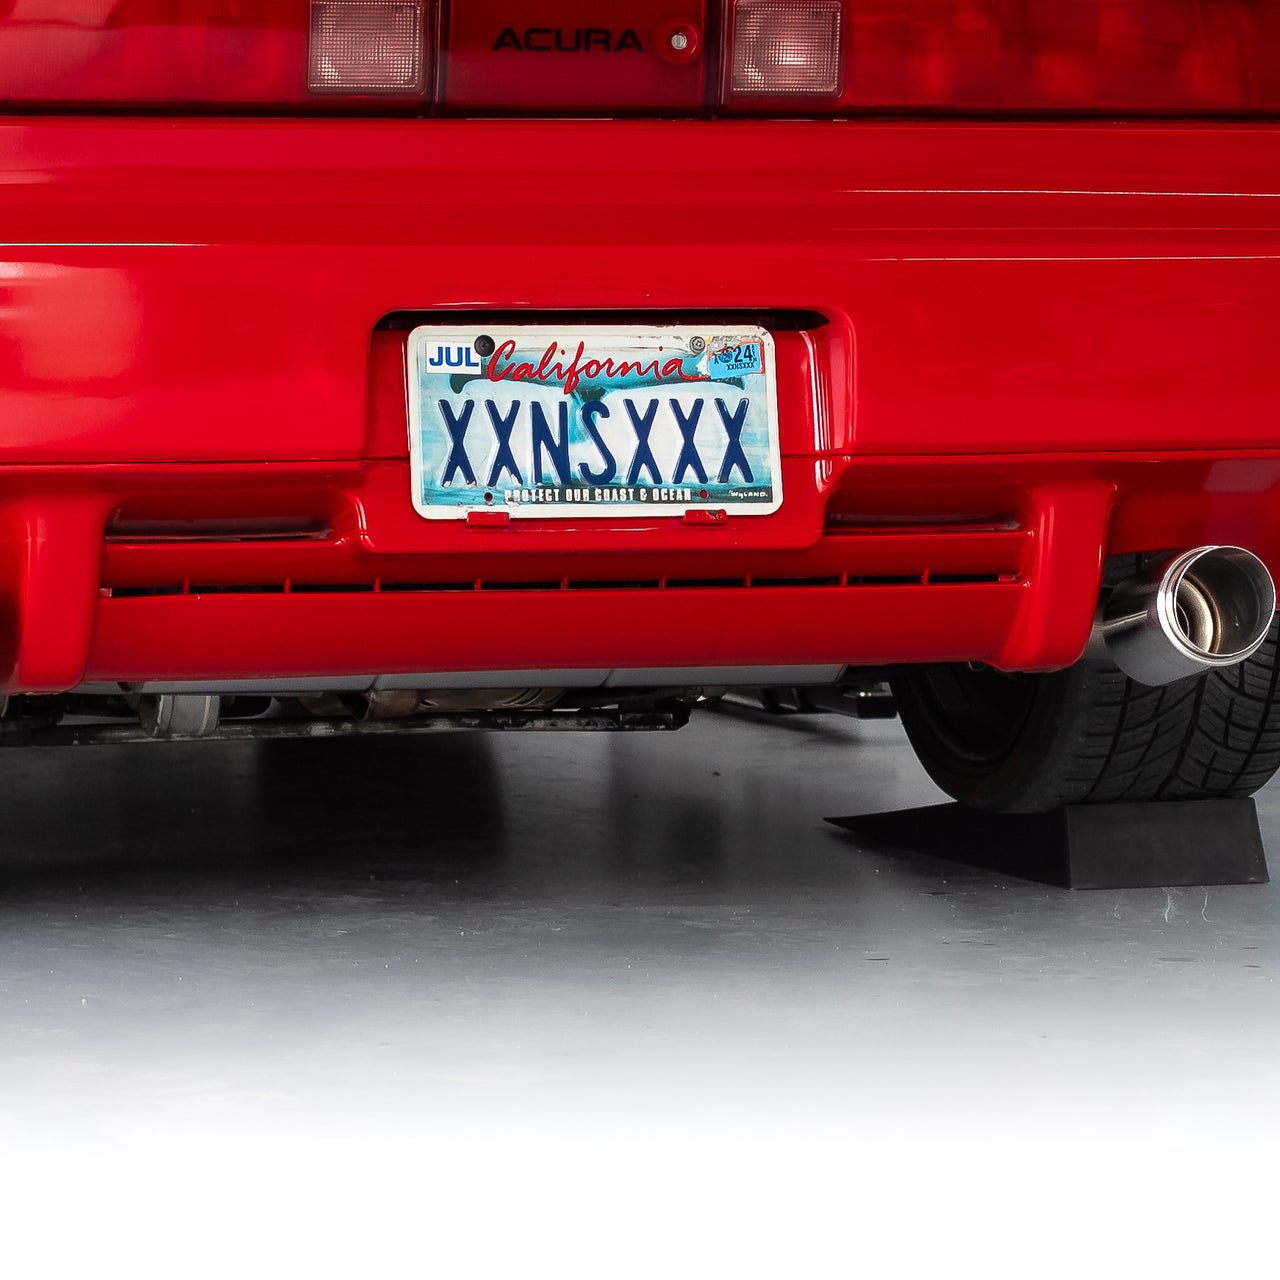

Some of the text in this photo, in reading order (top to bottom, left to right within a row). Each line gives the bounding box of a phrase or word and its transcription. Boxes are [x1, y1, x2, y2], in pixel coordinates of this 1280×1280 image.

[492, 27, 644, 52] ACURA
[428, 346, 480, 368] JUL
[733, 344, 753, 363] 24
[487, 339, 708, 396] California
[438, 398, 754, 487] XXNSXXX
[504, 487, 692, 502] PROTECT OUR COAST & OCEAN
